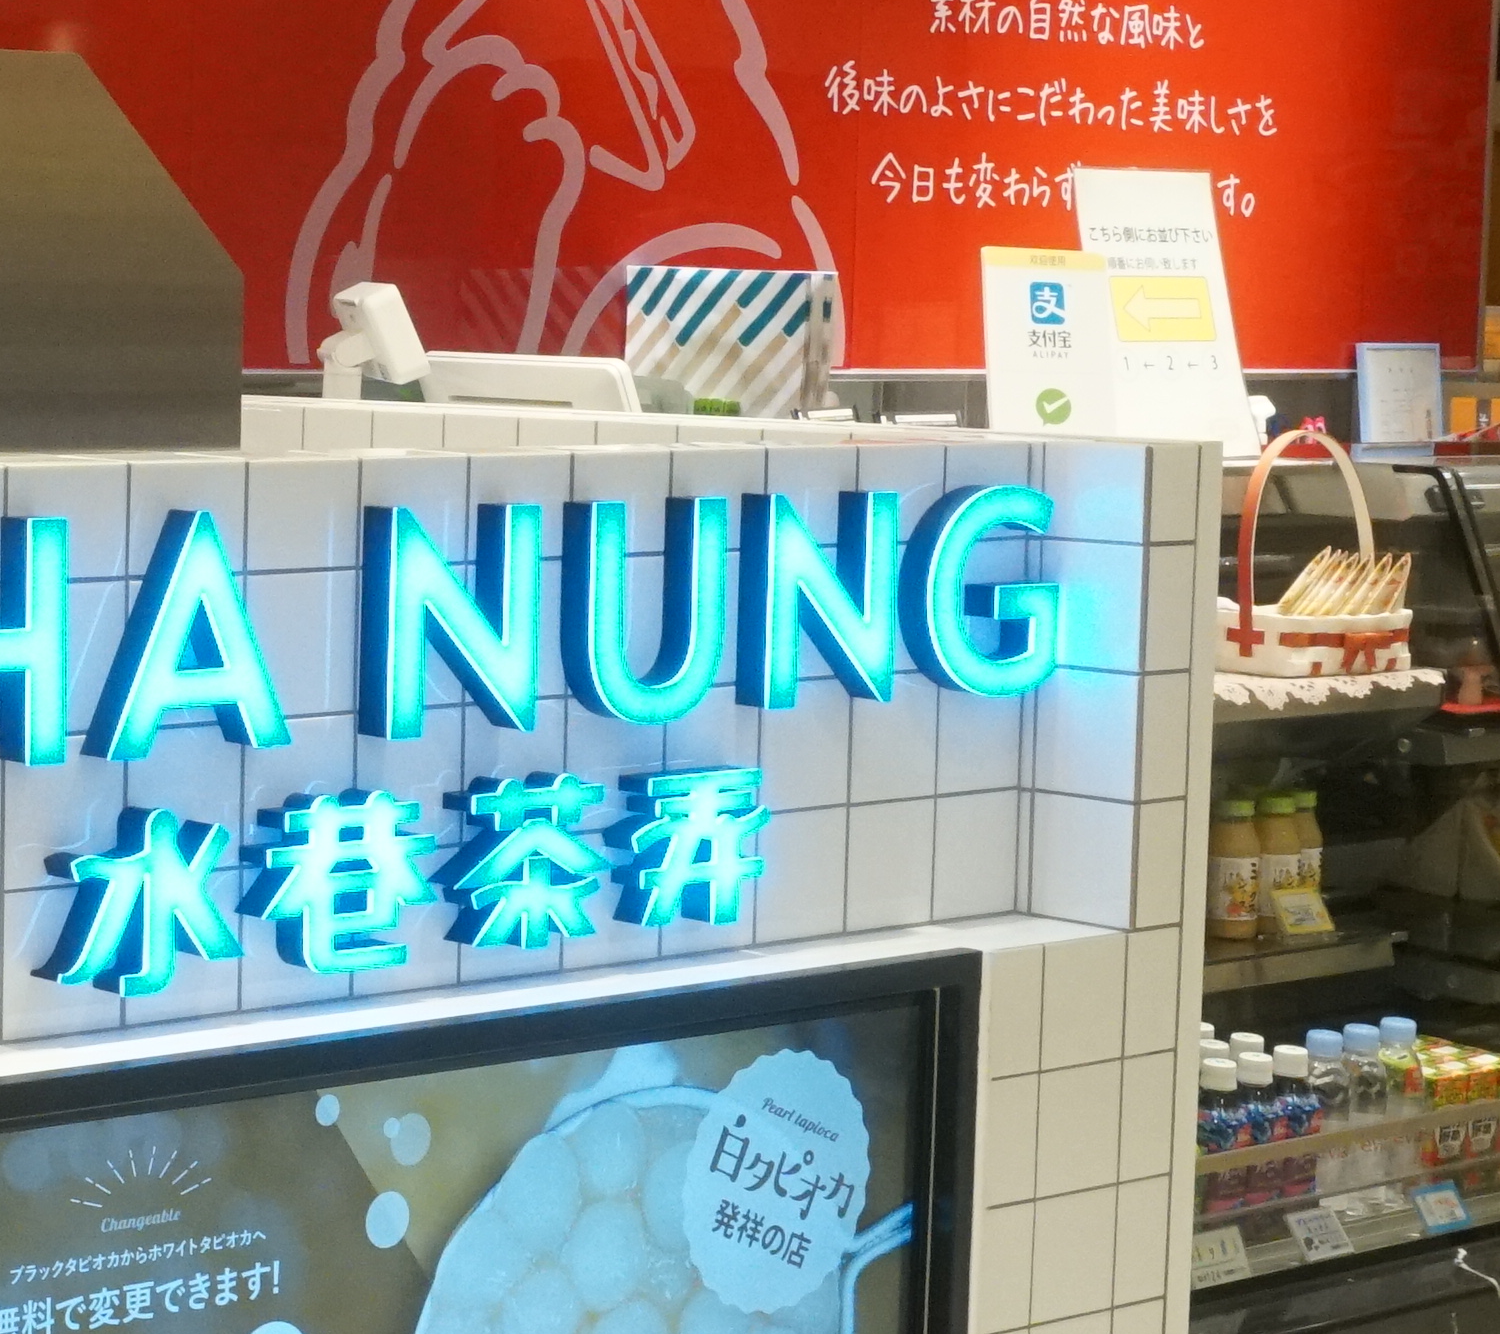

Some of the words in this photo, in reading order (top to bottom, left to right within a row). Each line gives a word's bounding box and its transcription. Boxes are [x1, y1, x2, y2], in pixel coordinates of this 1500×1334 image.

[825, 60, 1279, 137] 後味のよさにこだわった美味しさを
[1088, 225, 1214, 244] こちら側にお並び下さい
[1027, 330, 1073, 350] 支付宝
[1032, 350, 1070, 360] ALIPAY
[356, 482, 1063, 740] NUNG
[31, 764, 773, 998] 水巷茶弄
[761, 1096, 796, 1124] Pearl
[708, 1114, 856, 1221] 白タピオカ
[100, 1208, 182, 1234] Changeable
[711, 1199, 813, 1269] 発祥の店
[9, 1228, 267, 1285] ブラックタピオカからホワイトタピオカへ
